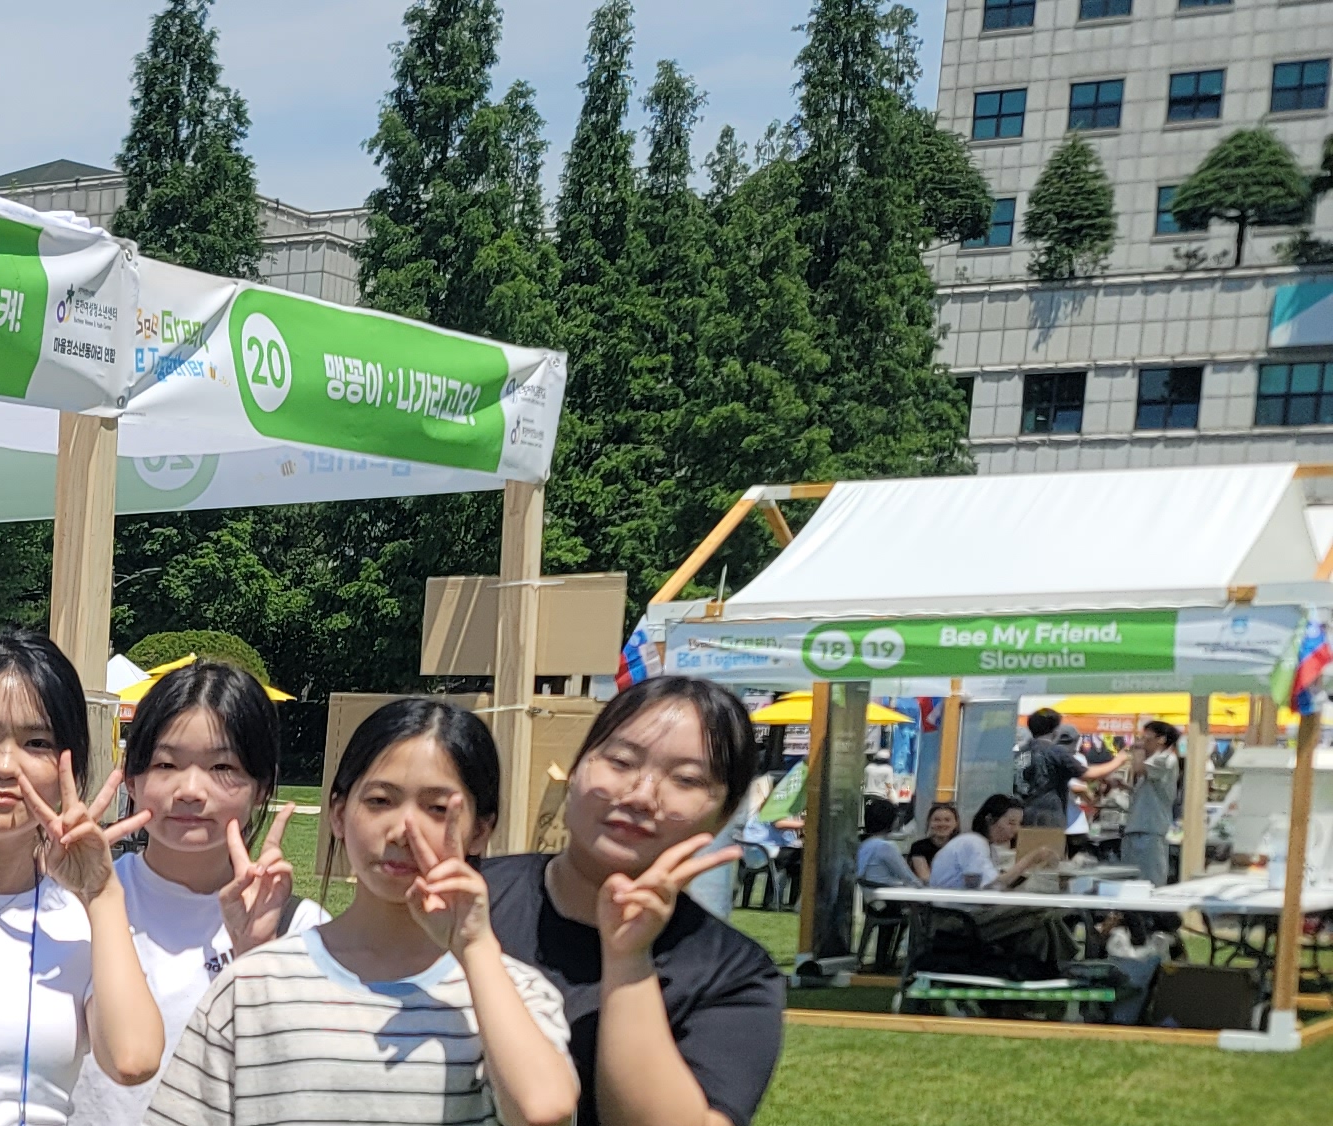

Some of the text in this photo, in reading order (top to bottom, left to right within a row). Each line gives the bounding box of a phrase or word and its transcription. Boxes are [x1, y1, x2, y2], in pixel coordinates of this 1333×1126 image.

[246, 333, 285, 389] 20
[323, 353, 384, 408] 맹꽁이
[818, 640, 895, 660] 18 19
[939, 625, 987, 647] Bee
[992, 624, 1031, 652] My
[677, 652, 701, 668] Be
[978, 646, 1086, 671] Slovenia
